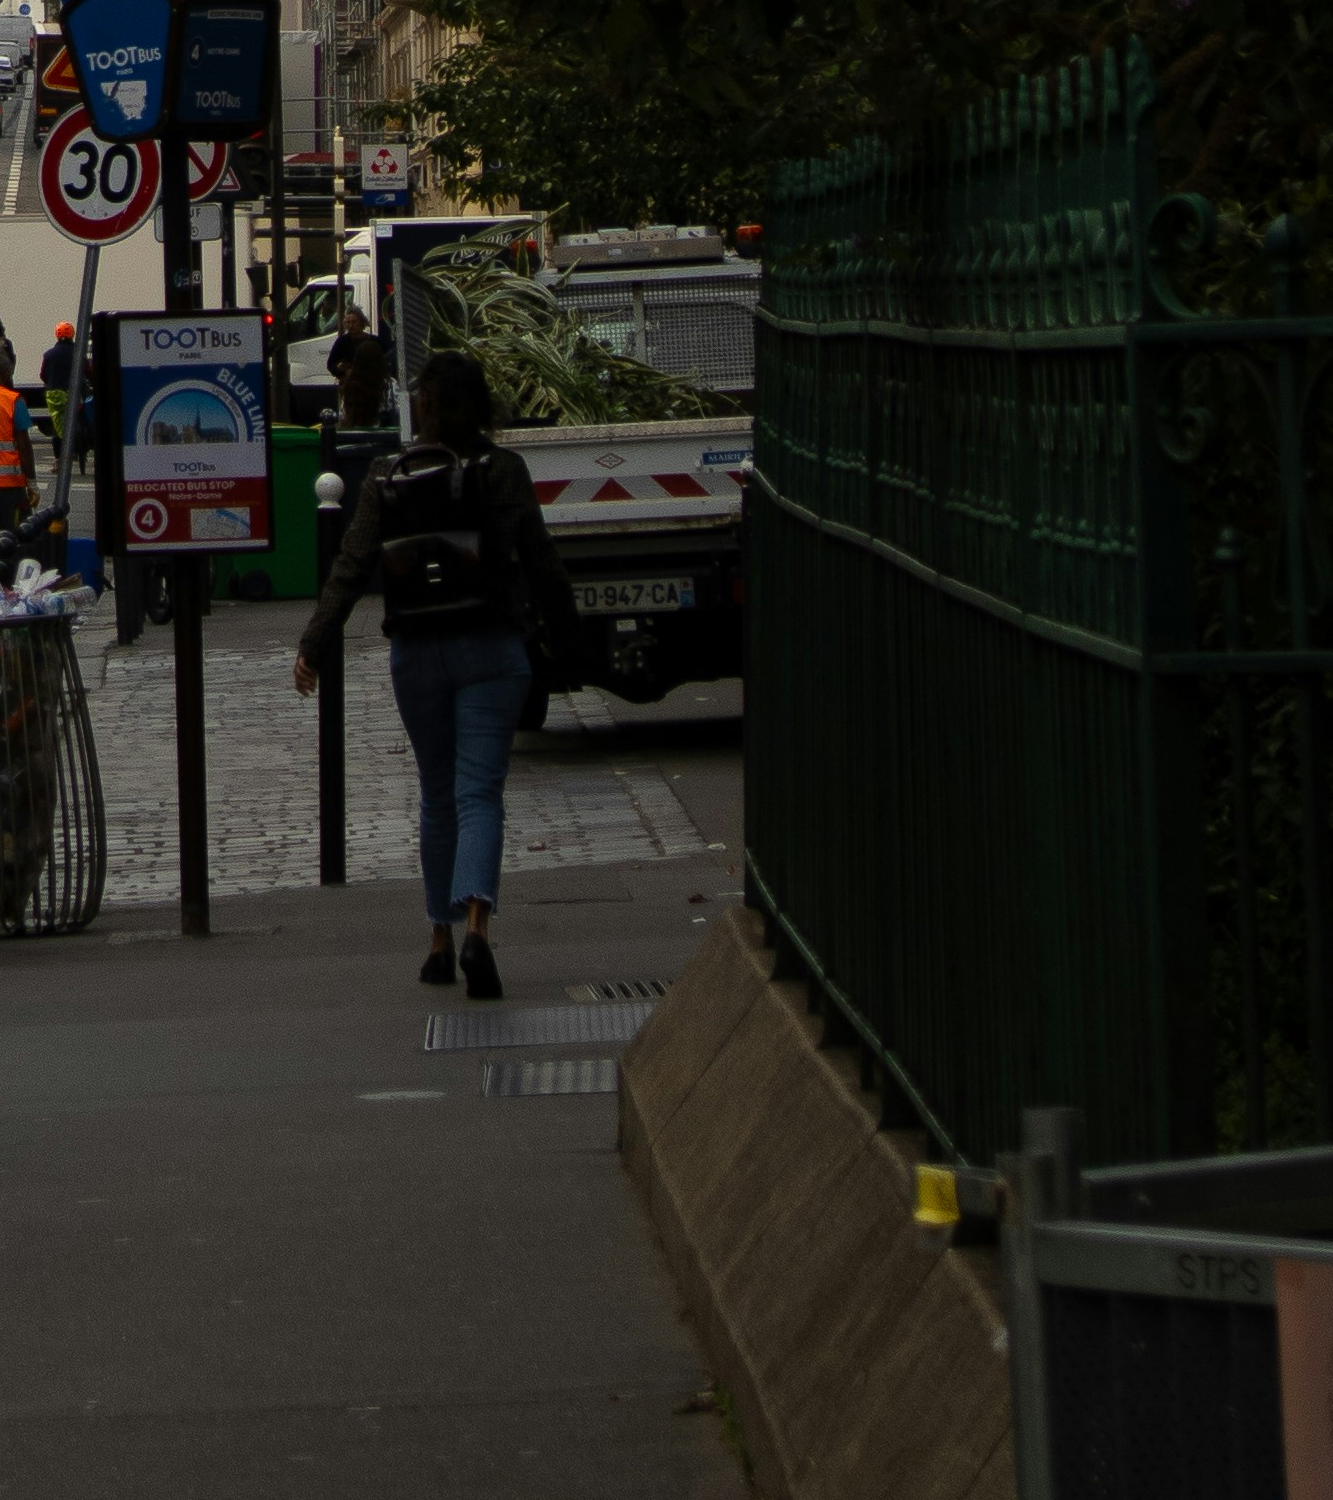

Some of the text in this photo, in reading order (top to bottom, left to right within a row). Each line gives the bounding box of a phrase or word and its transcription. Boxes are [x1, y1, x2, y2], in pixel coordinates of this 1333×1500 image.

[190, 44, 200, 60] 4
[63, 140, 138, 203] 30
[216, 367, 266, 444] BLUE LINE
[127, 480, 236, 493] RELOCATED BUS STOP
[168, 492, 223, 500] Notre-Dame
[141, 510, 155, 527] 4
[572, 582, 679, 607] FD-947-CA
[1177, 1253, 1261, 1295] STPS
